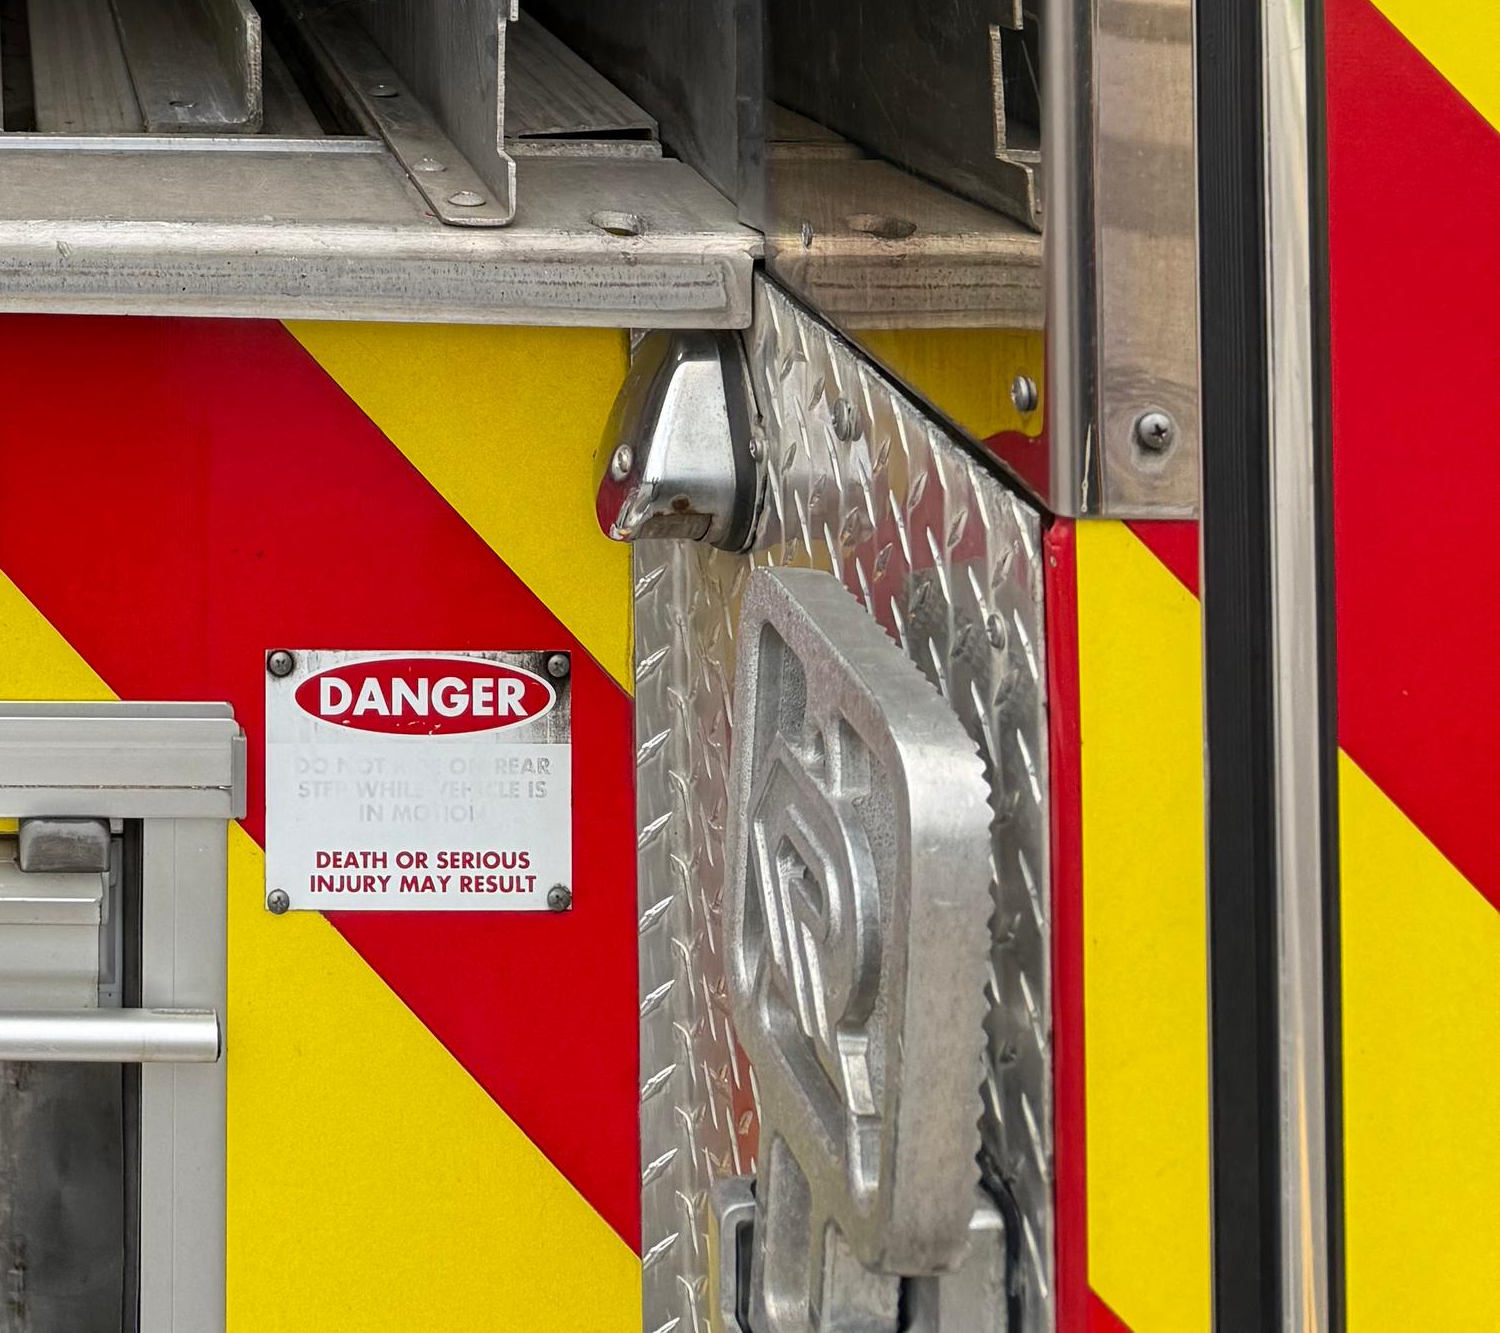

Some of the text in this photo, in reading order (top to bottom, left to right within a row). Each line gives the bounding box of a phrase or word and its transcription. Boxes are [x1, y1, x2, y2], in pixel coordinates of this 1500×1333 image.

[319, 676, 529, 717] DANGER
[495, 757, 552, 775] REAR
[528, 780, 548, 798] IS
[359, 804, 383, 822] IN
[316, 851, 530, 869] DEATH OR SERIOUS
[310, 875, 537, 893] INJURY MAY RESULT
